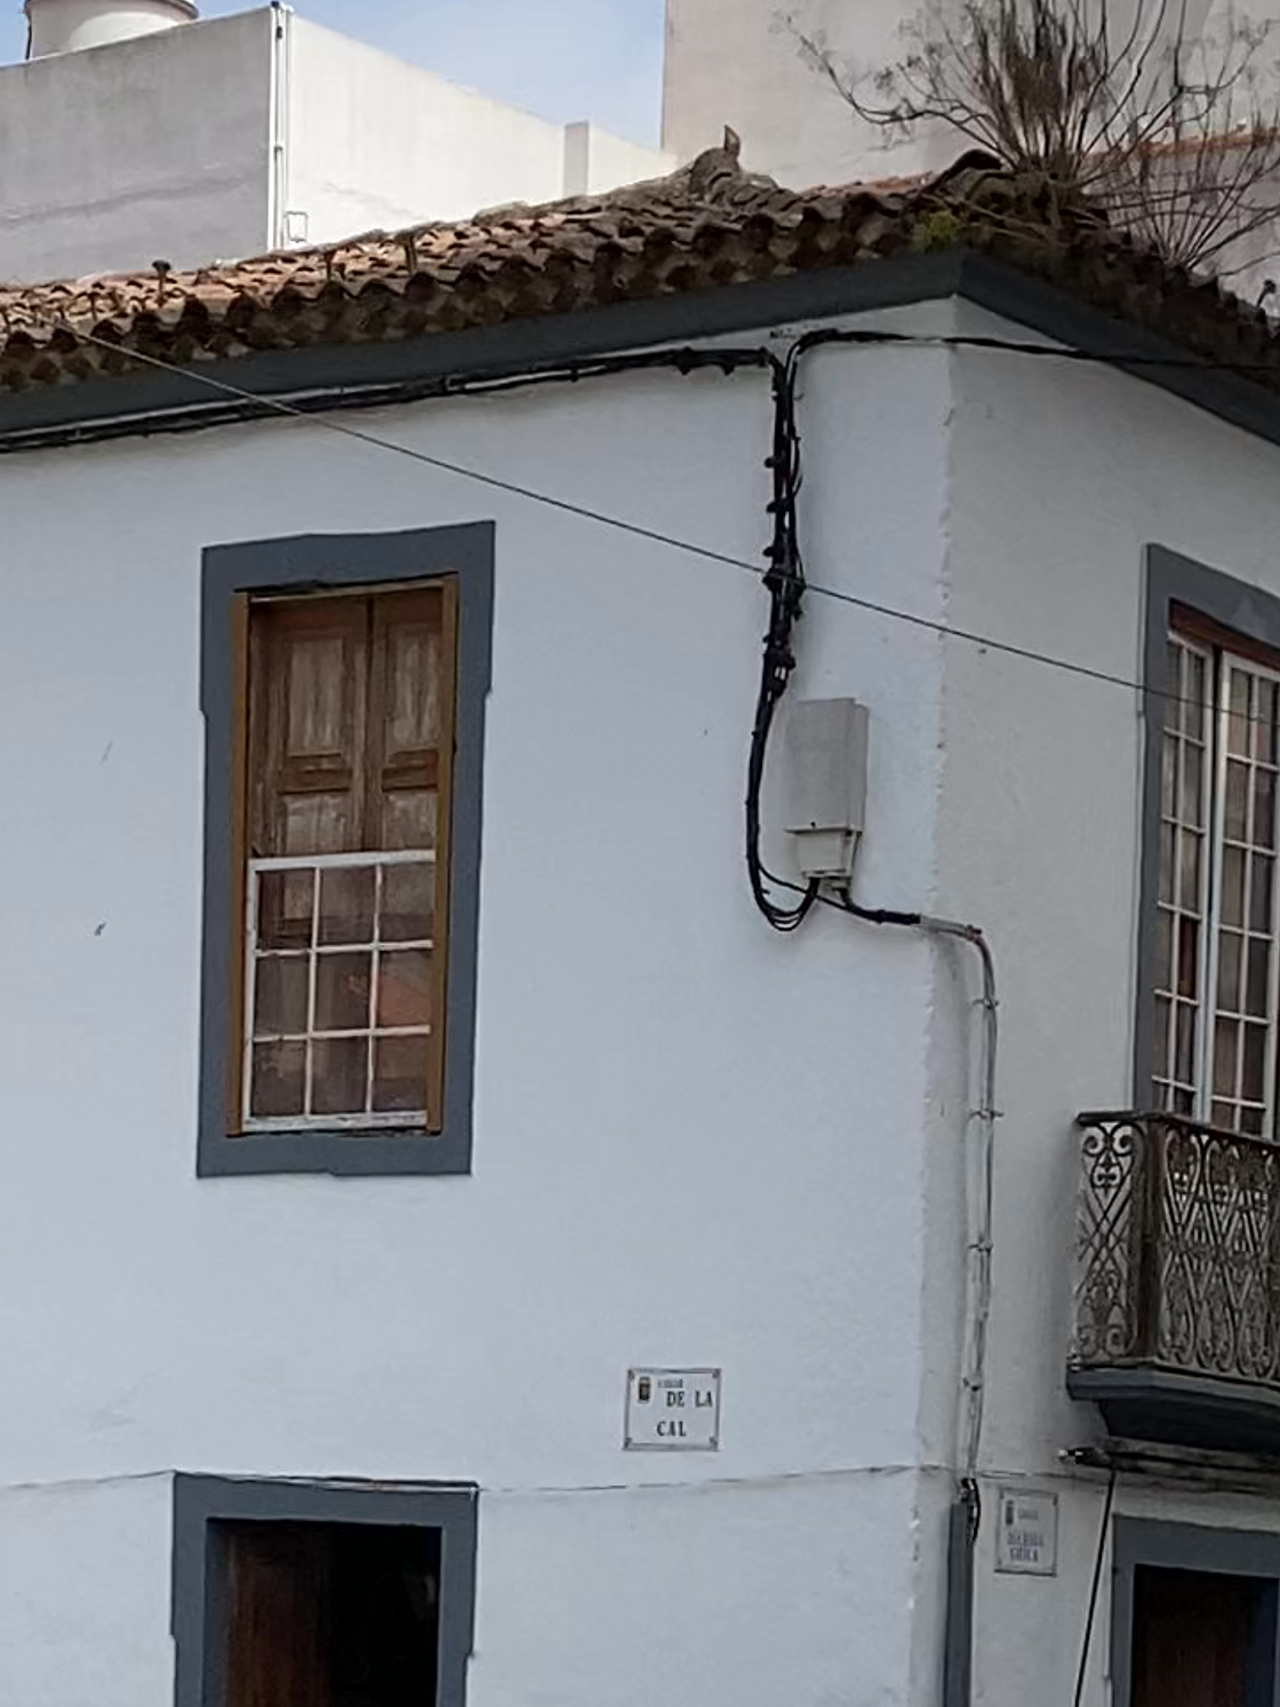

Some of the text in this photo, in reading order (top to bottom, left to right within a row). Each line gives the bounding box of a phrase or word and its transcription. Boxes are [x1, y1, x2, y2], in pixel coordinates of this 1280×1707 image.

[667, 1390, 713, 1408] DE LA
[656, 1420, 687, 1437] CAL
